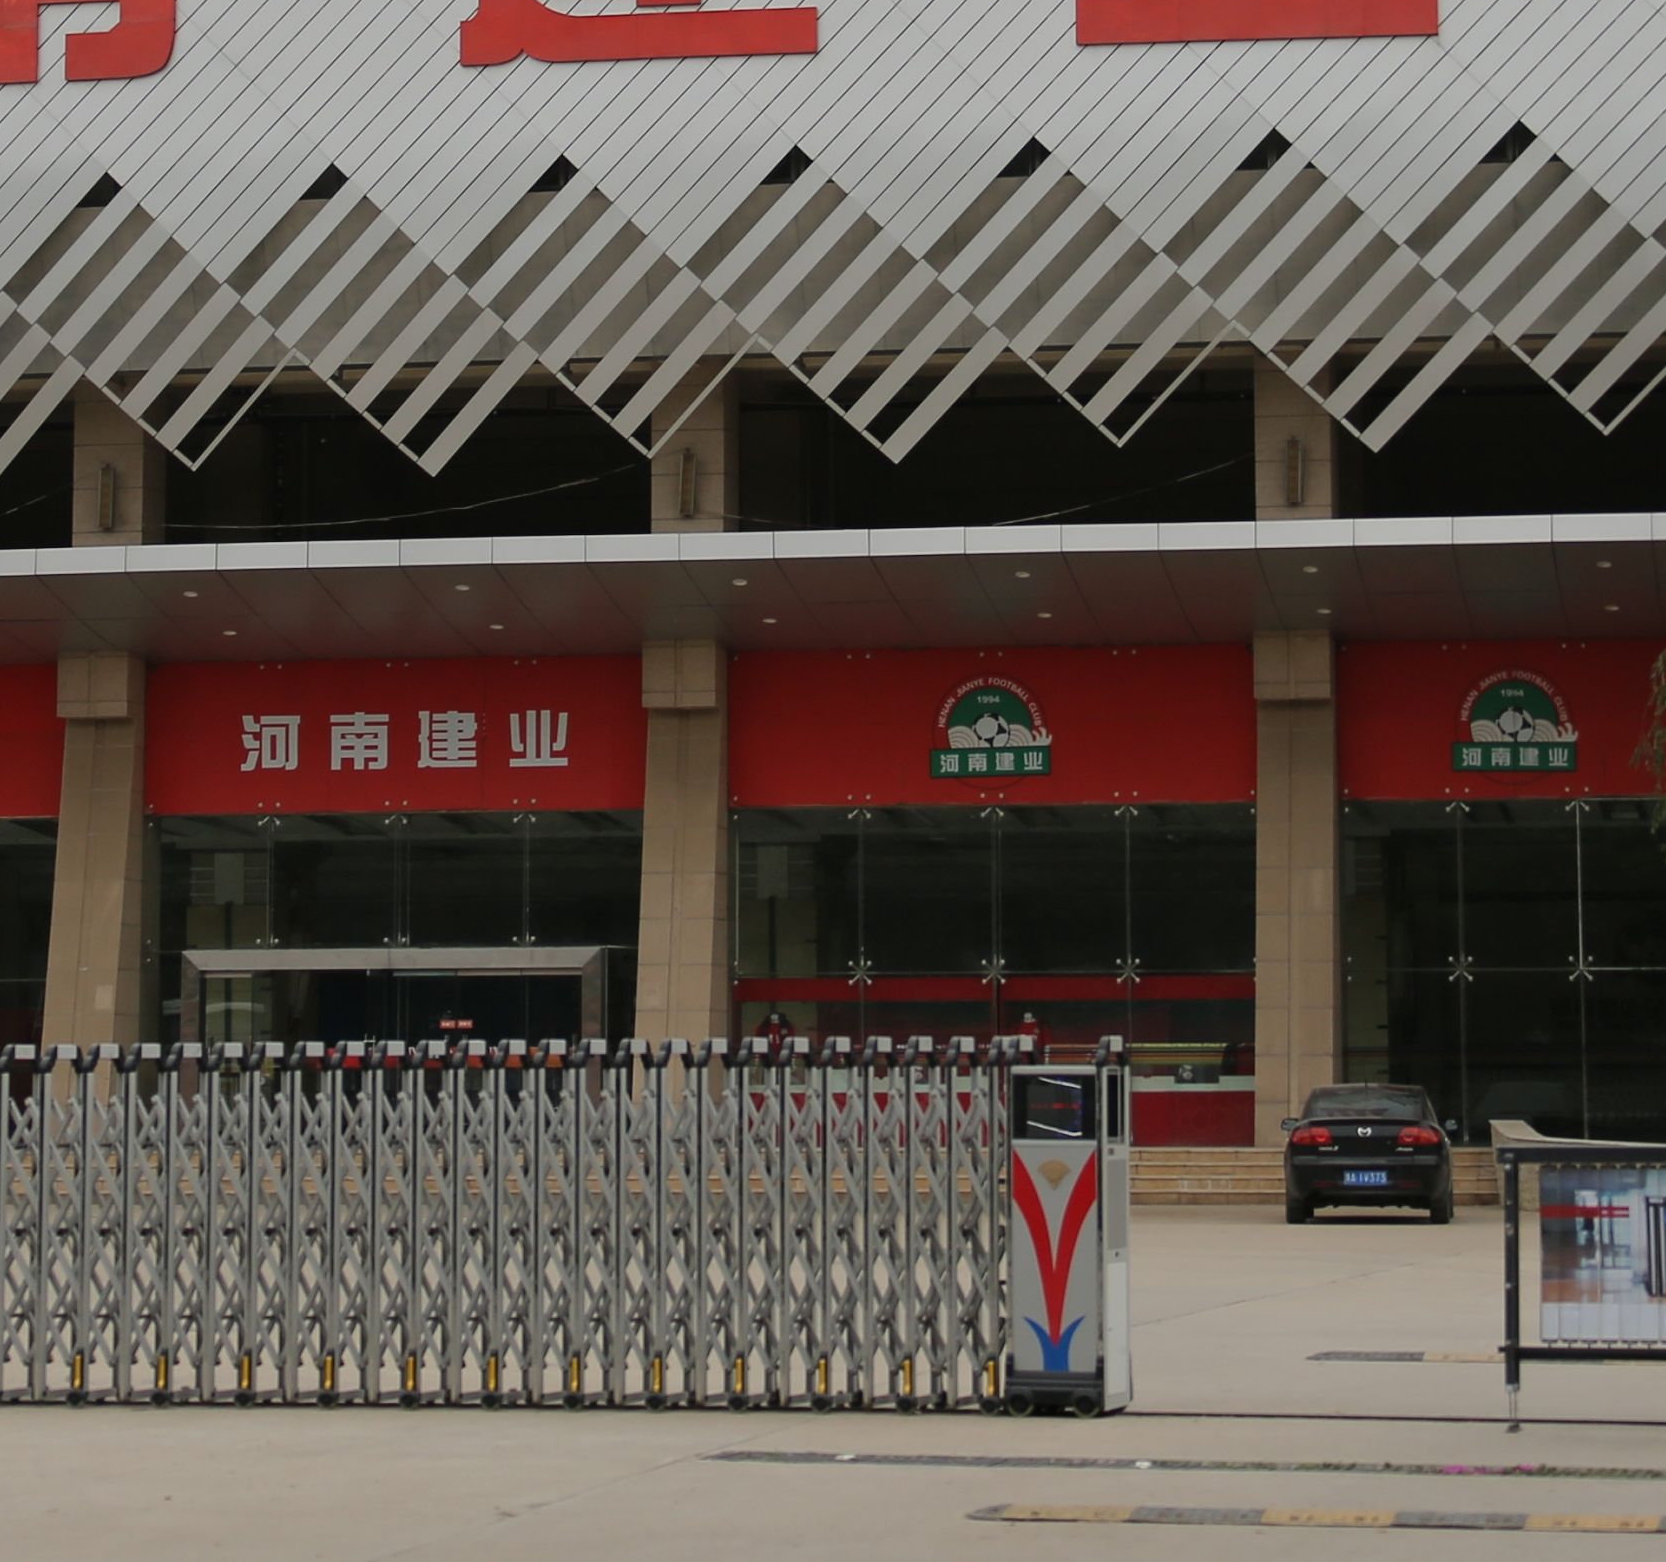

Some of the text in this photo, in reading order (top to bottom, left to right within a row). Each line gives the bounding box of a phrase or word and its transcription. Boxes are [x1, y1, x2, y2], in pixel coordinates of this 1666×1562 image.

[938, 696, 955, 728] HENAN
[988, 677, 1029, 701] FOOTBALL
[1028, 702, 1042, 726] CLUB
[240, 710, 568, 772] 河南建业
[1462, 747, 1568, 766] 河南建业
[940, 752, 1043, 773] 河南建业
